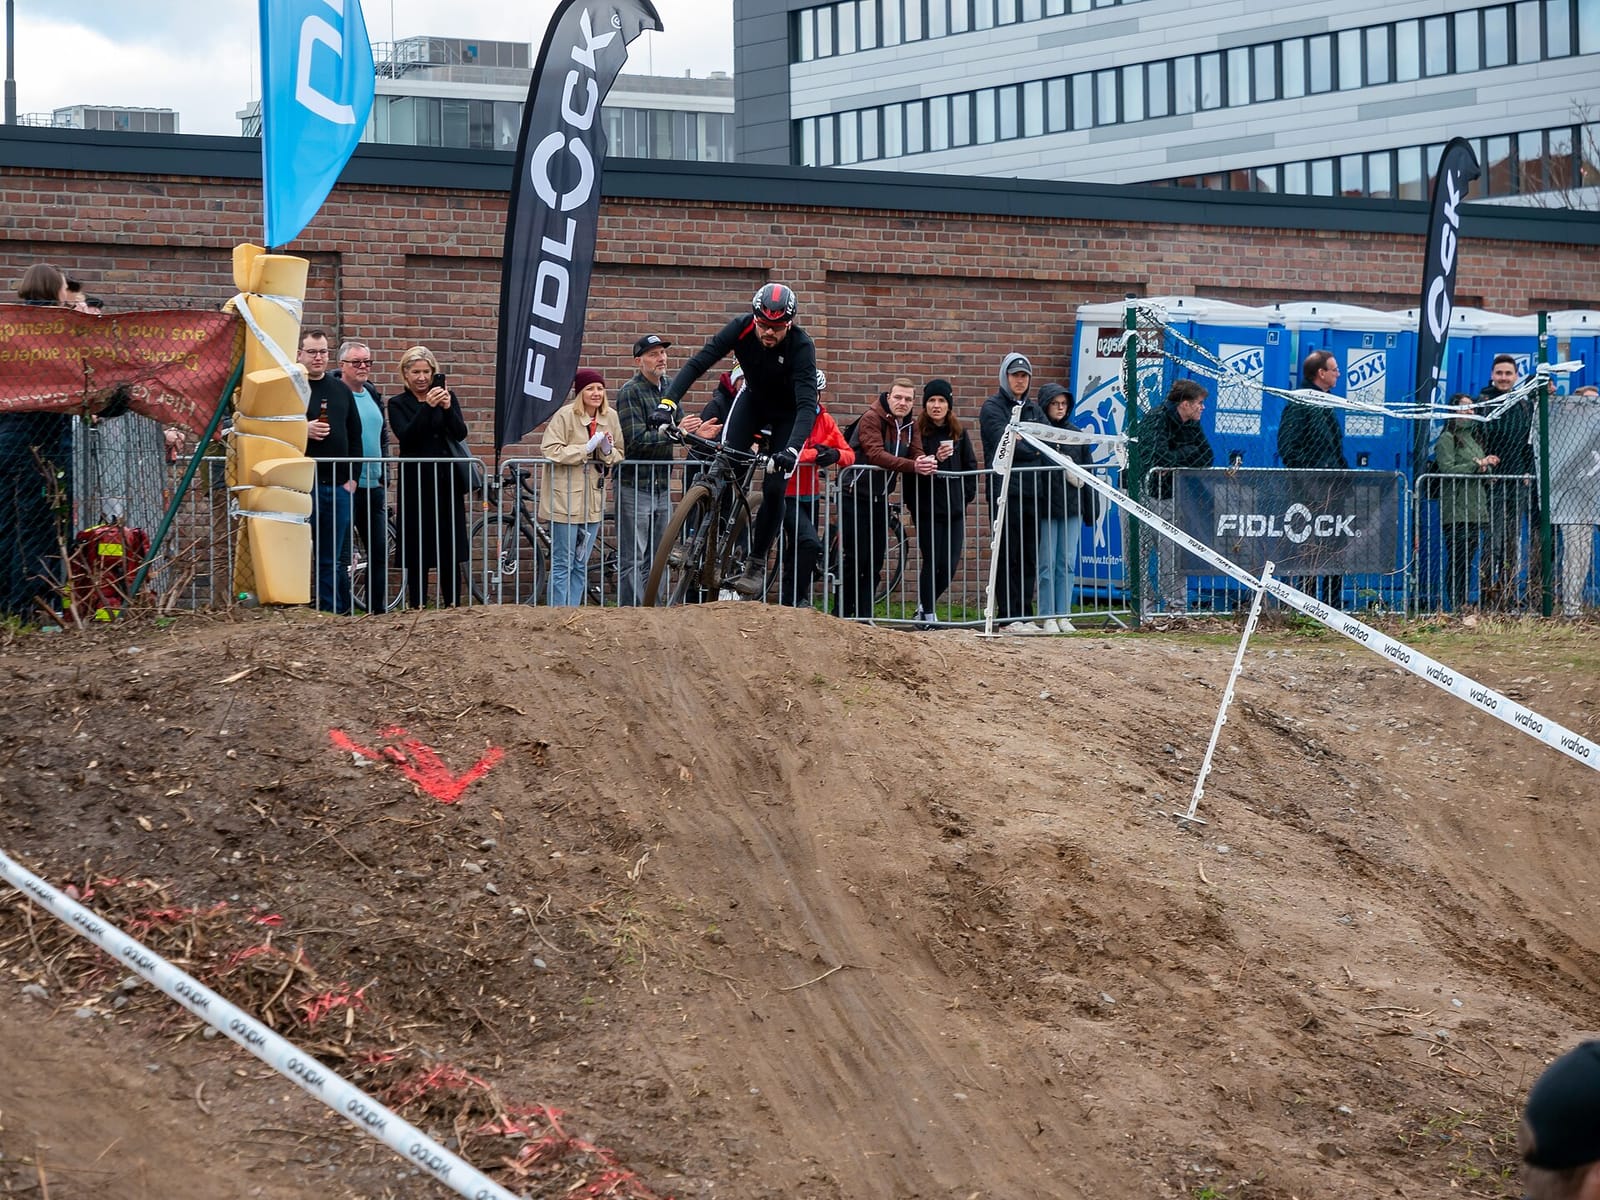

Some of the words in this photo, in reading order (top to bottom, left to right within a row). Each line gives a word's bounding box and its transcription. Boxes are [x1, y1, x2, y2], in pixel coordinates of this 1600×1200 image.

[1302, 600, 1329, 621] wahoo
[1343, 620, 1369, 642] wahoo
[1384, 642, 1411, 664] wahoo
[1426, 664, 1454, 687] wahoo
[1469, 686, 1498, 710] wahoo
[1513, 709, 1543, 734] wahoo
[1560, 733, 1590, 759] wahoo
